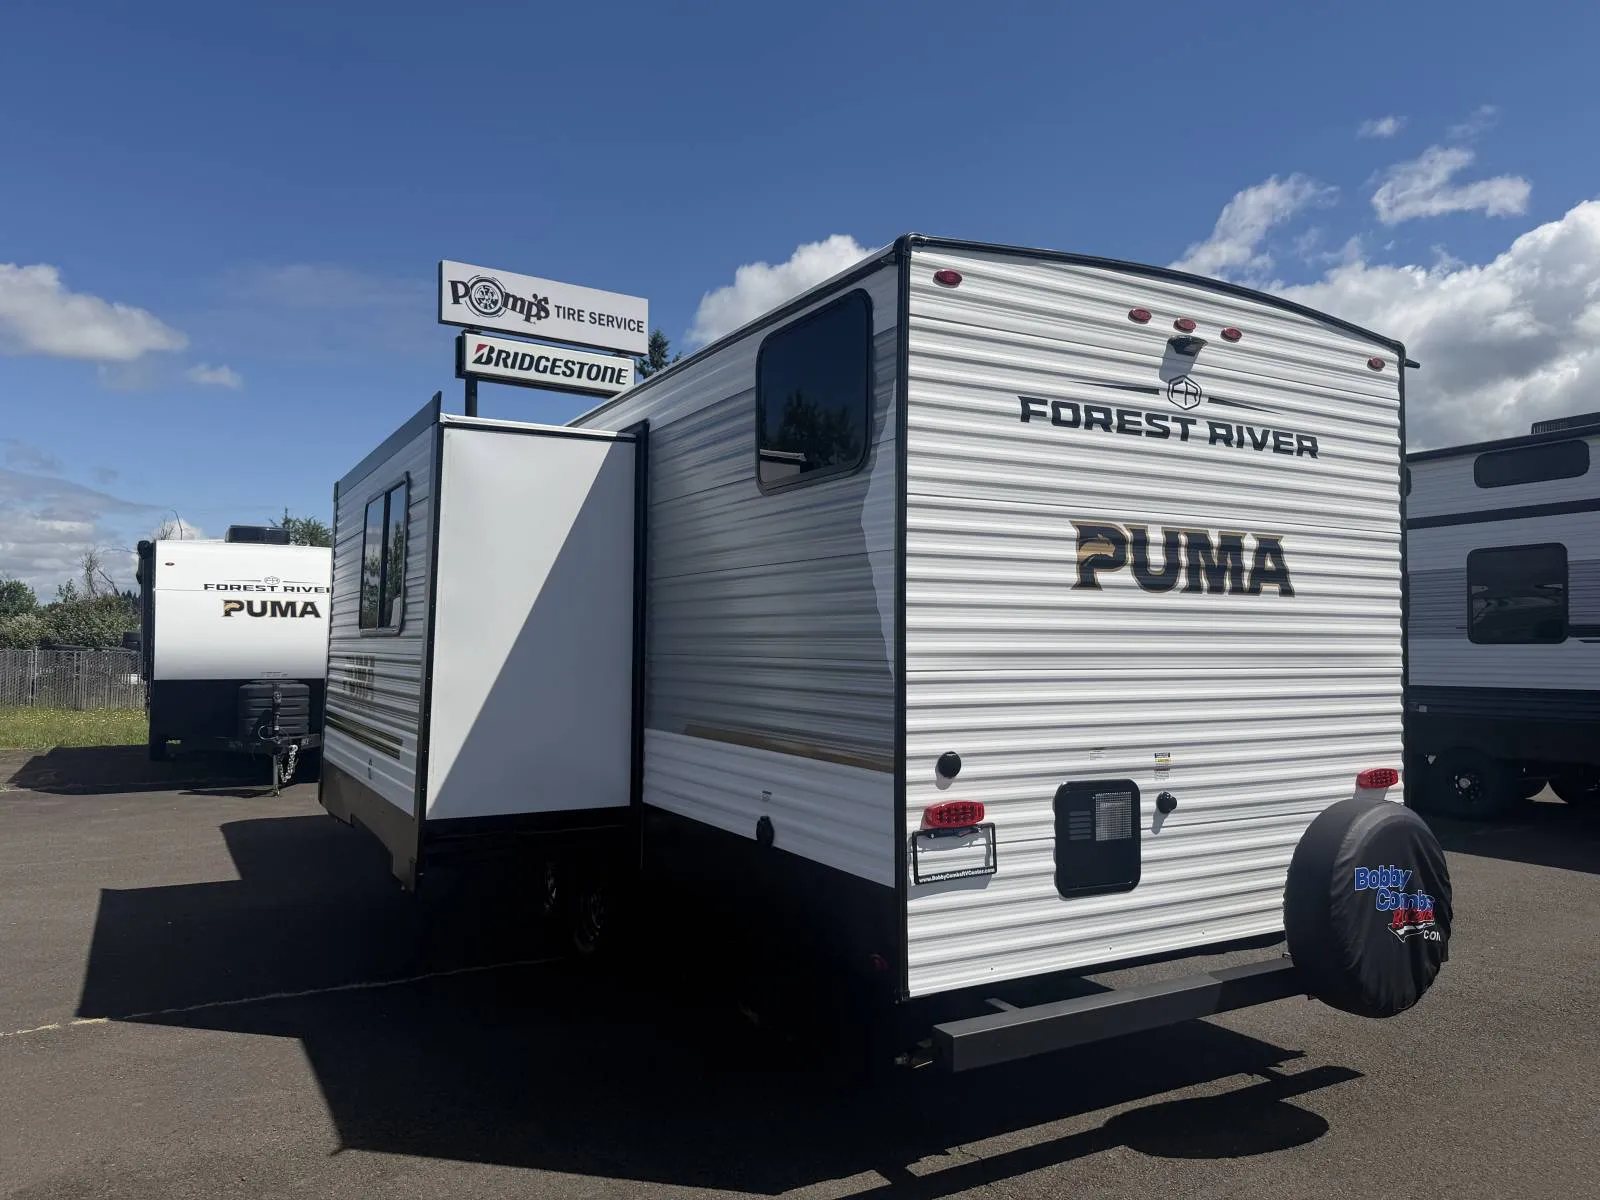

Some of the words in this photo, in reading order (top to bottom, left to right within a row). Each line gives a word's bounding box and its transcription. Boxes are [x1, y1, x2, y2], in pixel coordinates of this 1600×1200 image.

[554, 304, 585, 323] TIRE
[589, 311, 645, 334] SERVICE
[472, 344, 629, 385] BRIDGESTONE
[1017, 395, 1197, 442] FOREST
[1206, 420, 1320, 459] RIVER
[1068, 520, 1295, 597] PUMA
[203, 583, 279, 592] FOREST
[221, 599, 322, 618] PUMA
[1354, 864, 1412, 891] Bobby
[1376, 887, 1436, 912] Combs
